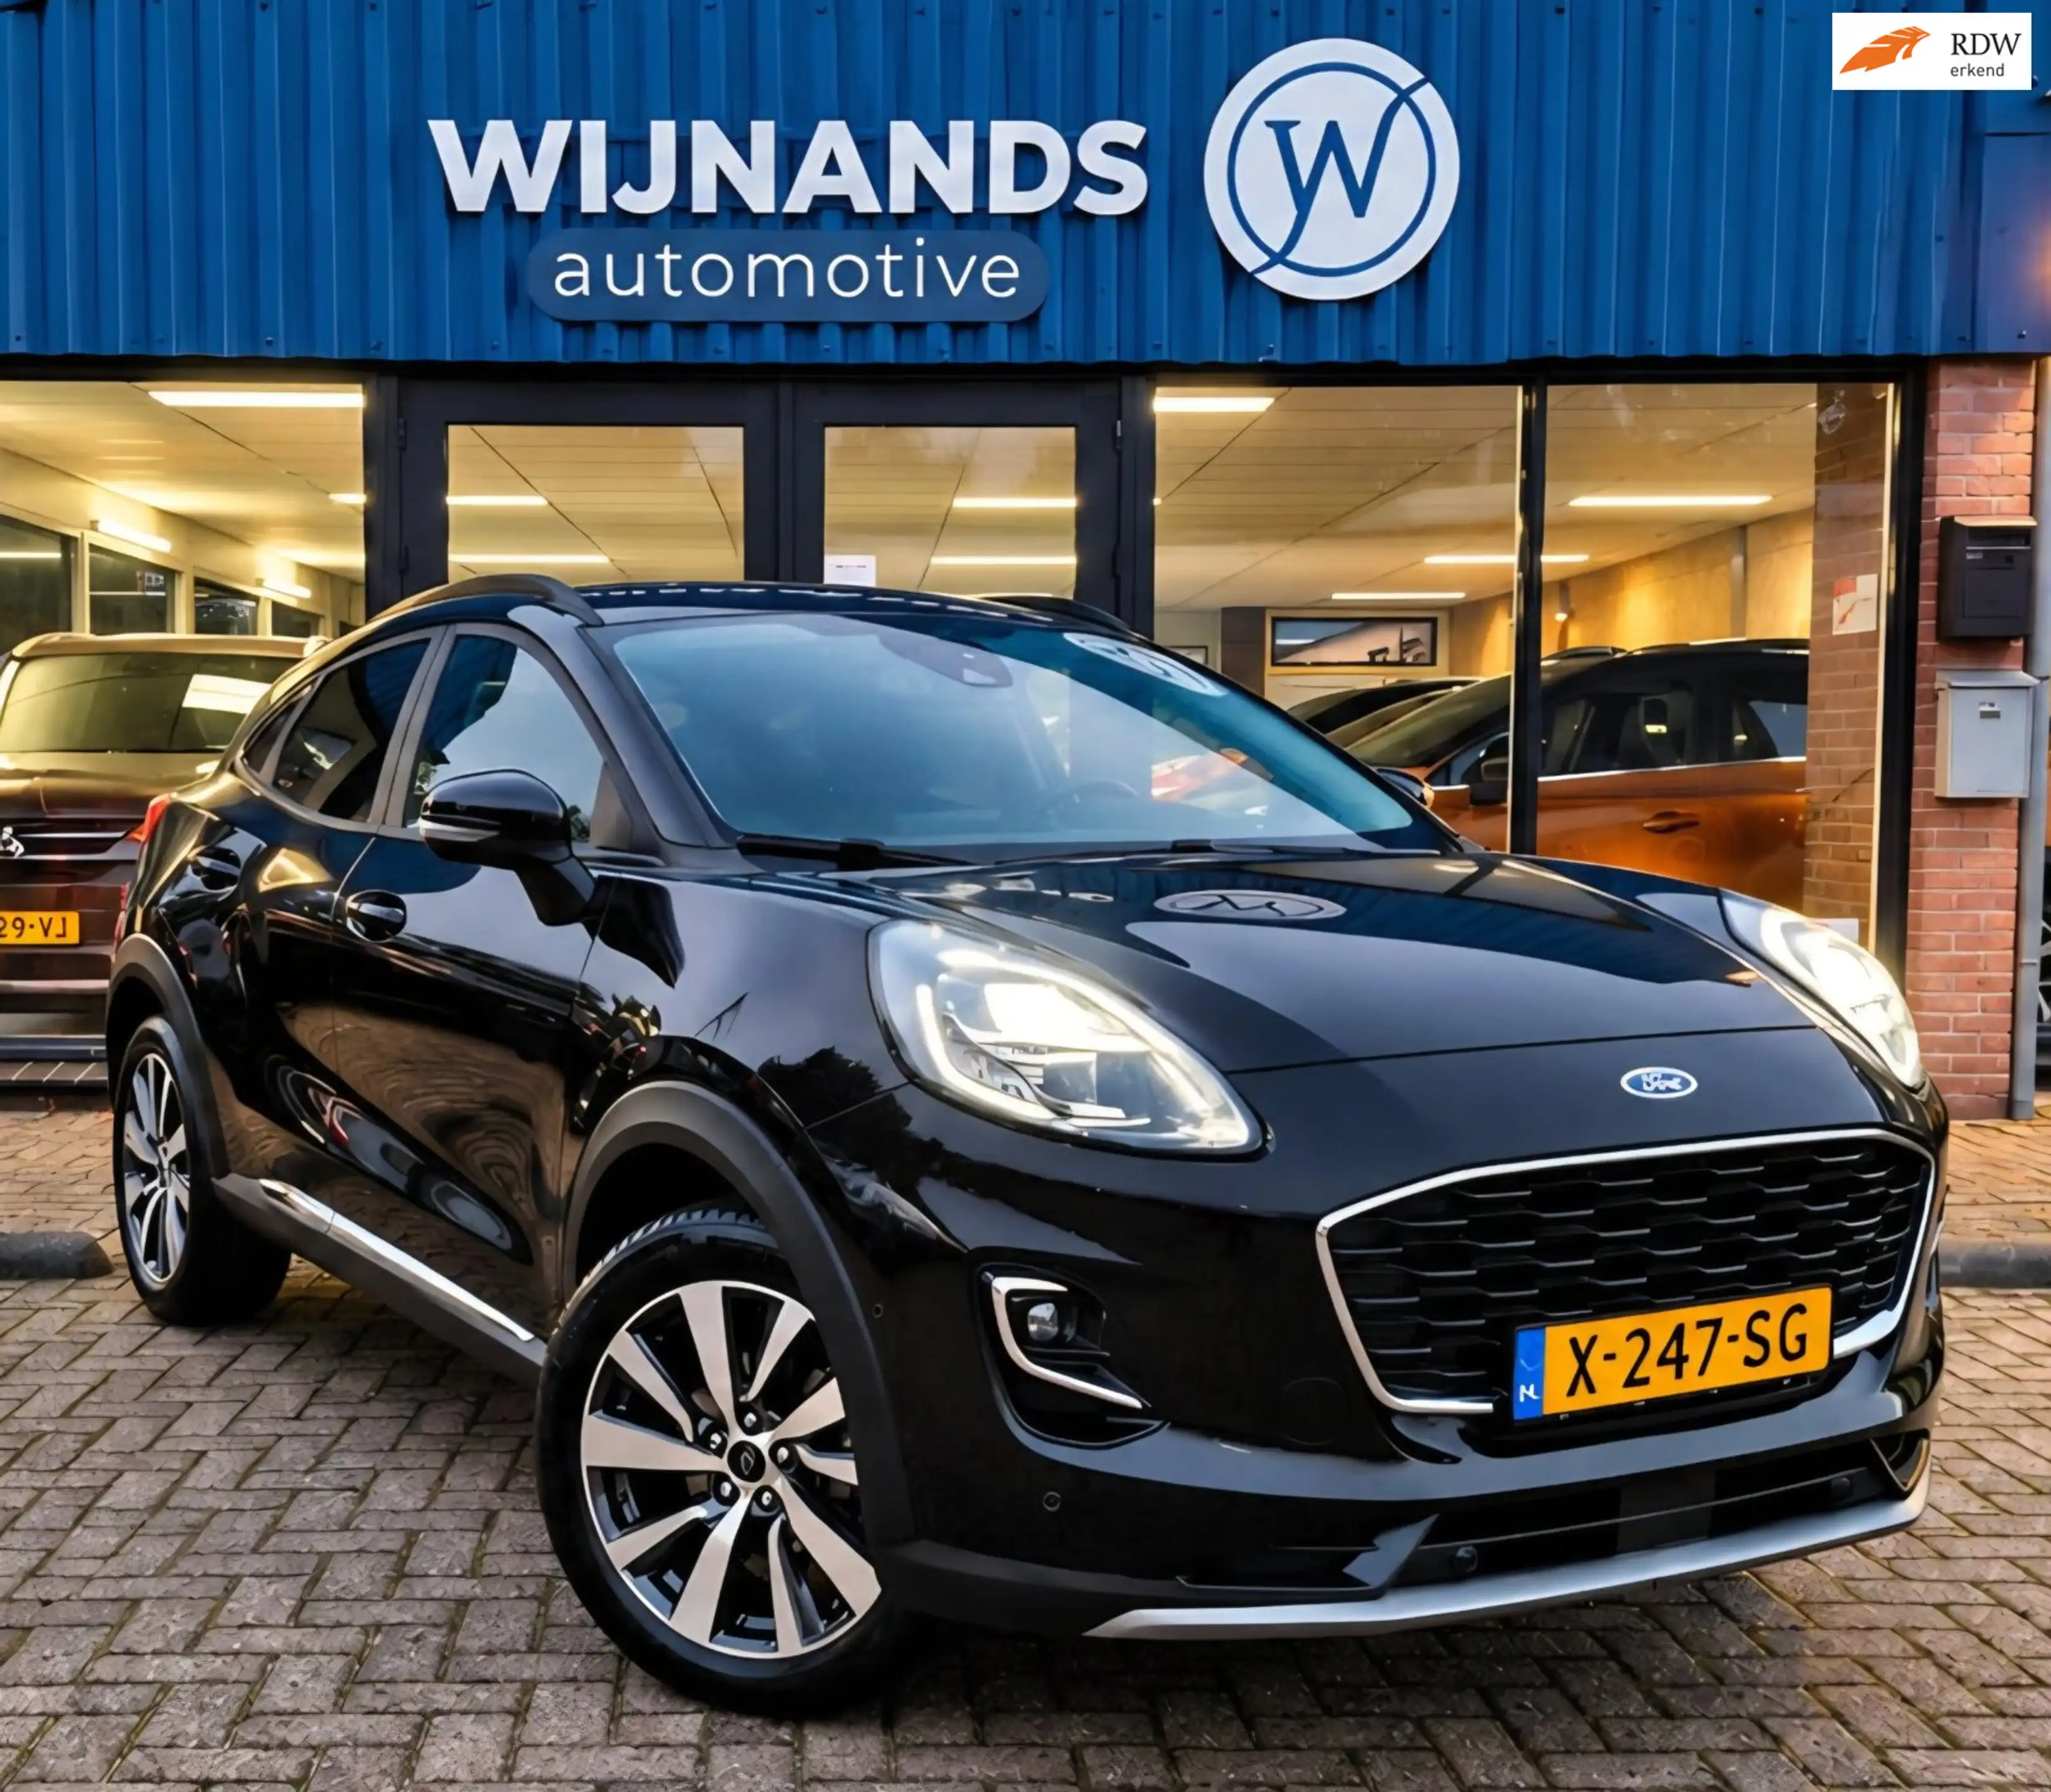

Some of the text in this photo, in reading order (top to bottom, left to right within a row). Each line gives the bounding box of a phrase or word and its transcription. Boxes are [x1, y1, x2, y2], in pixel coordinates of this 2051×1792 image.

[427, 119, 1148, 216] WIJNANDS
[553, 236, 1020, 298] automotive
[1565, 1302, 1808, 1398] X-247-SG
